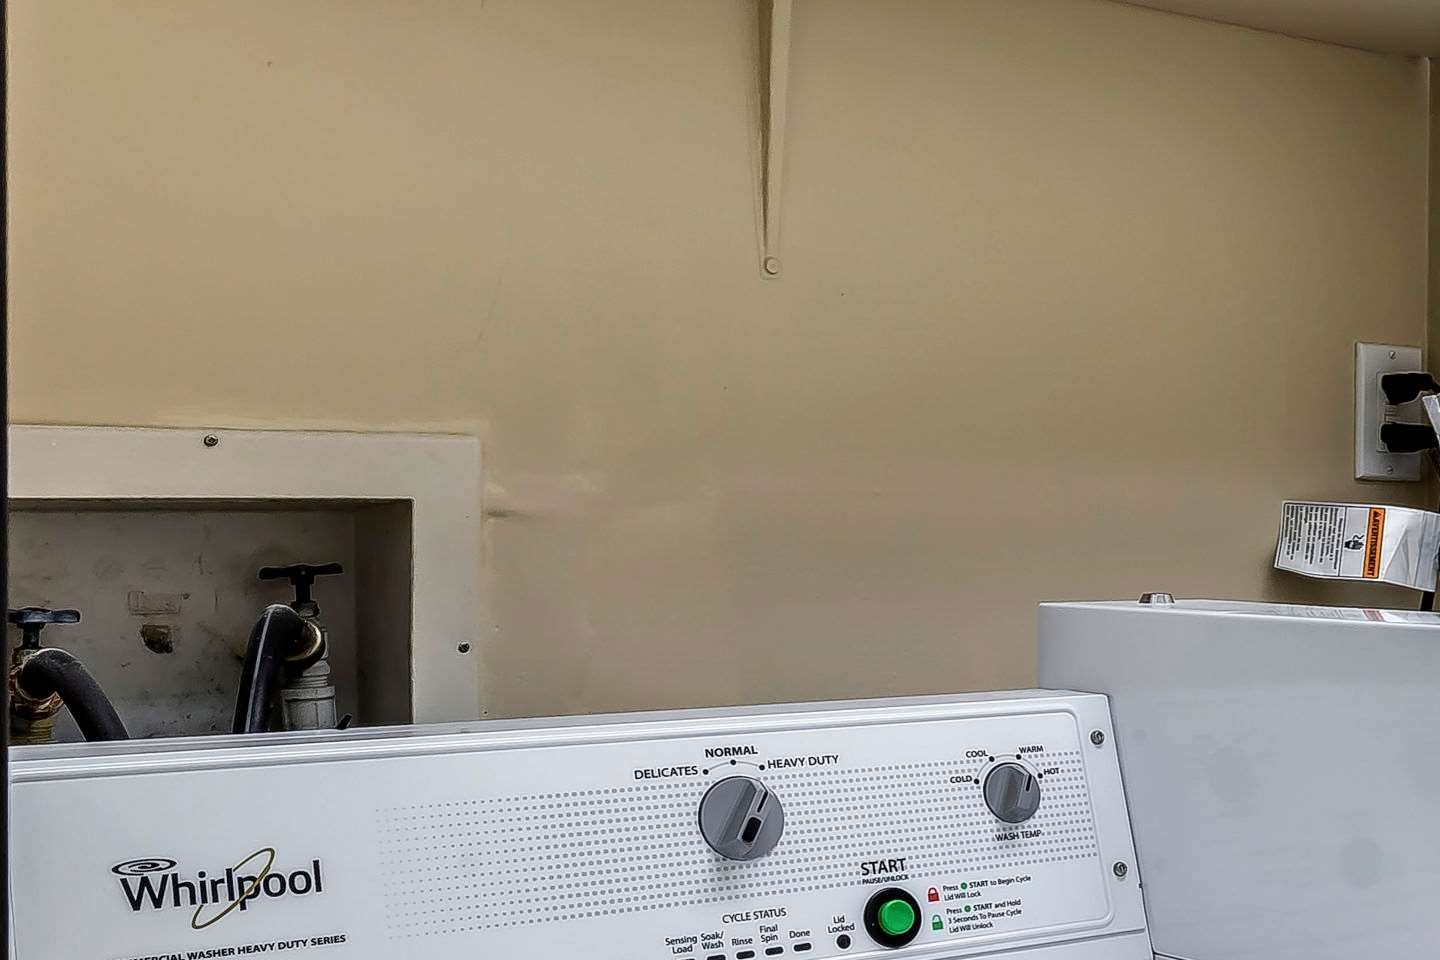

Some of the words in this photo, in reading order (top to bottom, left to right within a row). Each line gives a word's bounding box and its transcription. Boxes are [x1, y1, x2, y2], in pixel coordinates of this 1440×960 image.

[704, 745, 758, 758] NORMAL
[965, 750, 989, 759] COOL
[1019, 745, 1044, 754] WARM
[767, 757, 806, 769] HEAVY
[808, 755, 839, 766] DUTY
[634, 765, 698, 780] DELICATES
[1043, 767, 1060, 775] HOT
[949, 775, 972, 784] COLD
[995, 831, 1019, 841] WASH
[1020, 829, 1042, 839] TEMP
[860, 858, 907, 876] START
[119, 859, 323, 911] Whirlpool
[969, 880, 988, 889] START
[997, 877, 1015, 885] Begin
[1015, 875, 1031, 884] Cycle
[966, 890, 981, 898] Lock
[946, 907, 962, 915] Press
[973, 903, 992, 911] START
[994, 901, 1006, 909] and
[1006, 899, 1021, 907] Hold
[722, 911, 751, 924] CYCLE
[752, 908, 787, 920] STATUS
[833, 915, 845, 924] Lid
[953, 915, 978, 923] Seconds
[987, 911, 1004, 919] Pause
[1006, 909, 1022, 917] Cycle
[759, 923, 778, 933] Final
[827, 923, 855, 934] Locked
[972, 922, 993, 930] Unlock
[700, 931, 724, 942] Soak/
[760, 933, 778, 944] Spin
[789, 929, 811, 939] Done
[237, 942, 275, 955] HEAVY
[277, 938, 309, 950] DUTY
[310, 934, 347, 946] SERIES
[665, 935, 698, 946] Sensing
[701, 940, 724, 950] Wash
[731, 937, 753, 946] Rinse
[672, 944, 693, 955] Load
